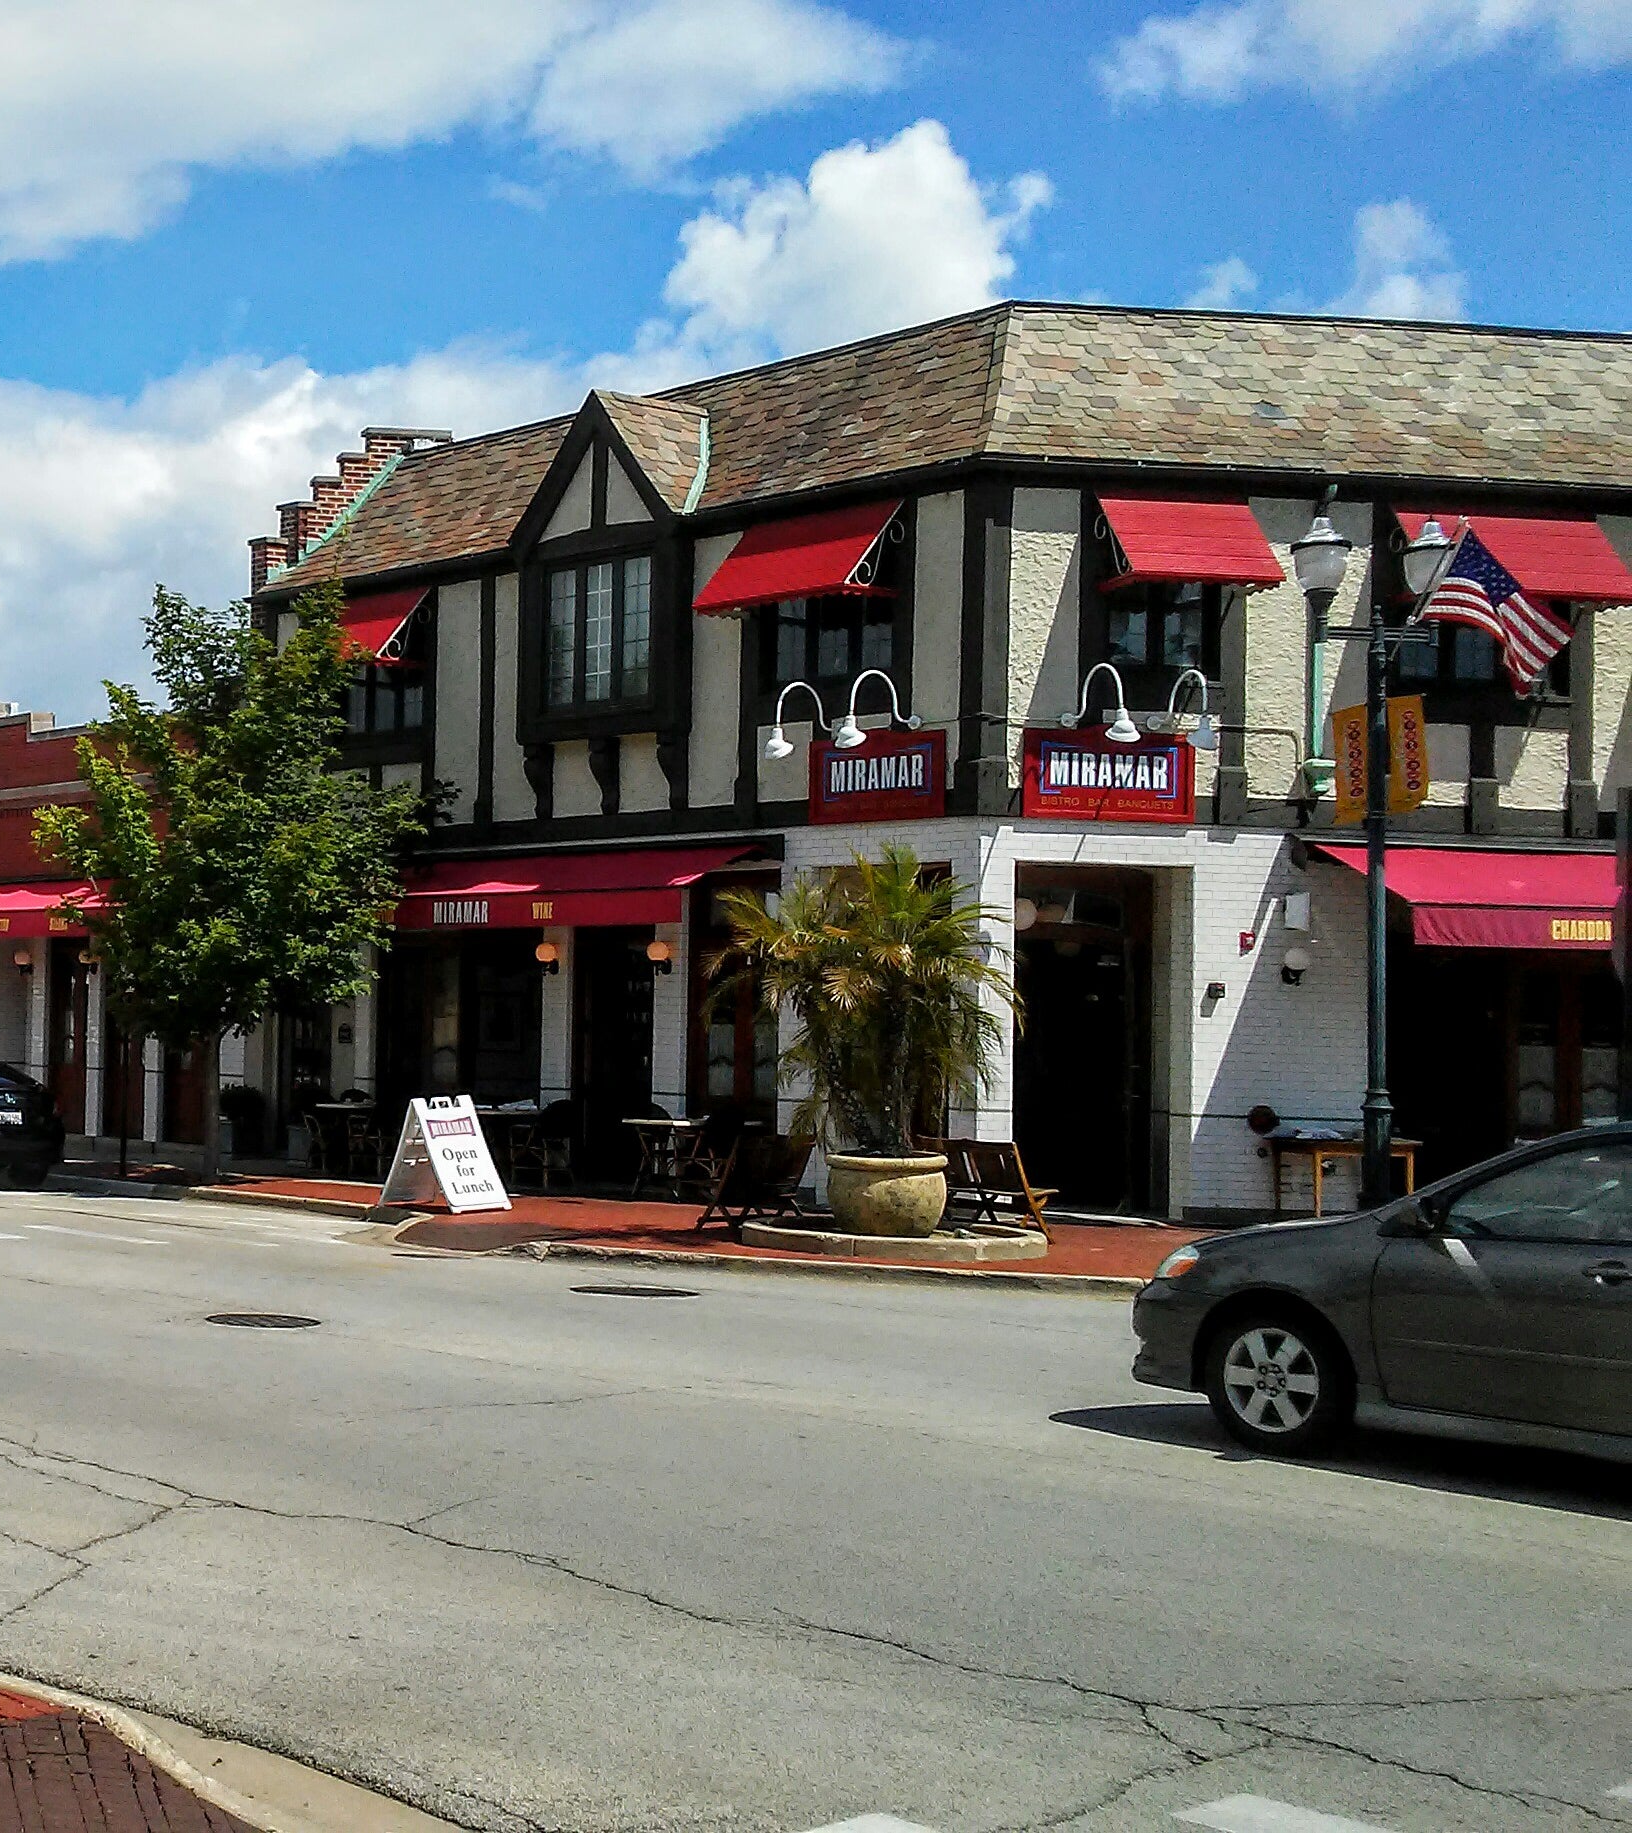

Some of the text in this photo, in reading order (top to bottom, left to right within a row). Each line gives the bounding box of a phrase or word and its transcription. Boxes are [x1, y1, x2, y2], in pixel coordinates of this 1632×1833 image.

[831, 754, 924, 793] MIRAMAR
[1049, 751, 1168, 790] MIRAMAR
[1041, 796, 1174, 810] BISTRO BAR BANQUETS
[433, 900, 554, 924] MIRAMAR WINE
[442, 1147, 478, 1162] Open
[456, 1164, 475, 1176] for
[451, 1180, 494, 1195] Lunch
